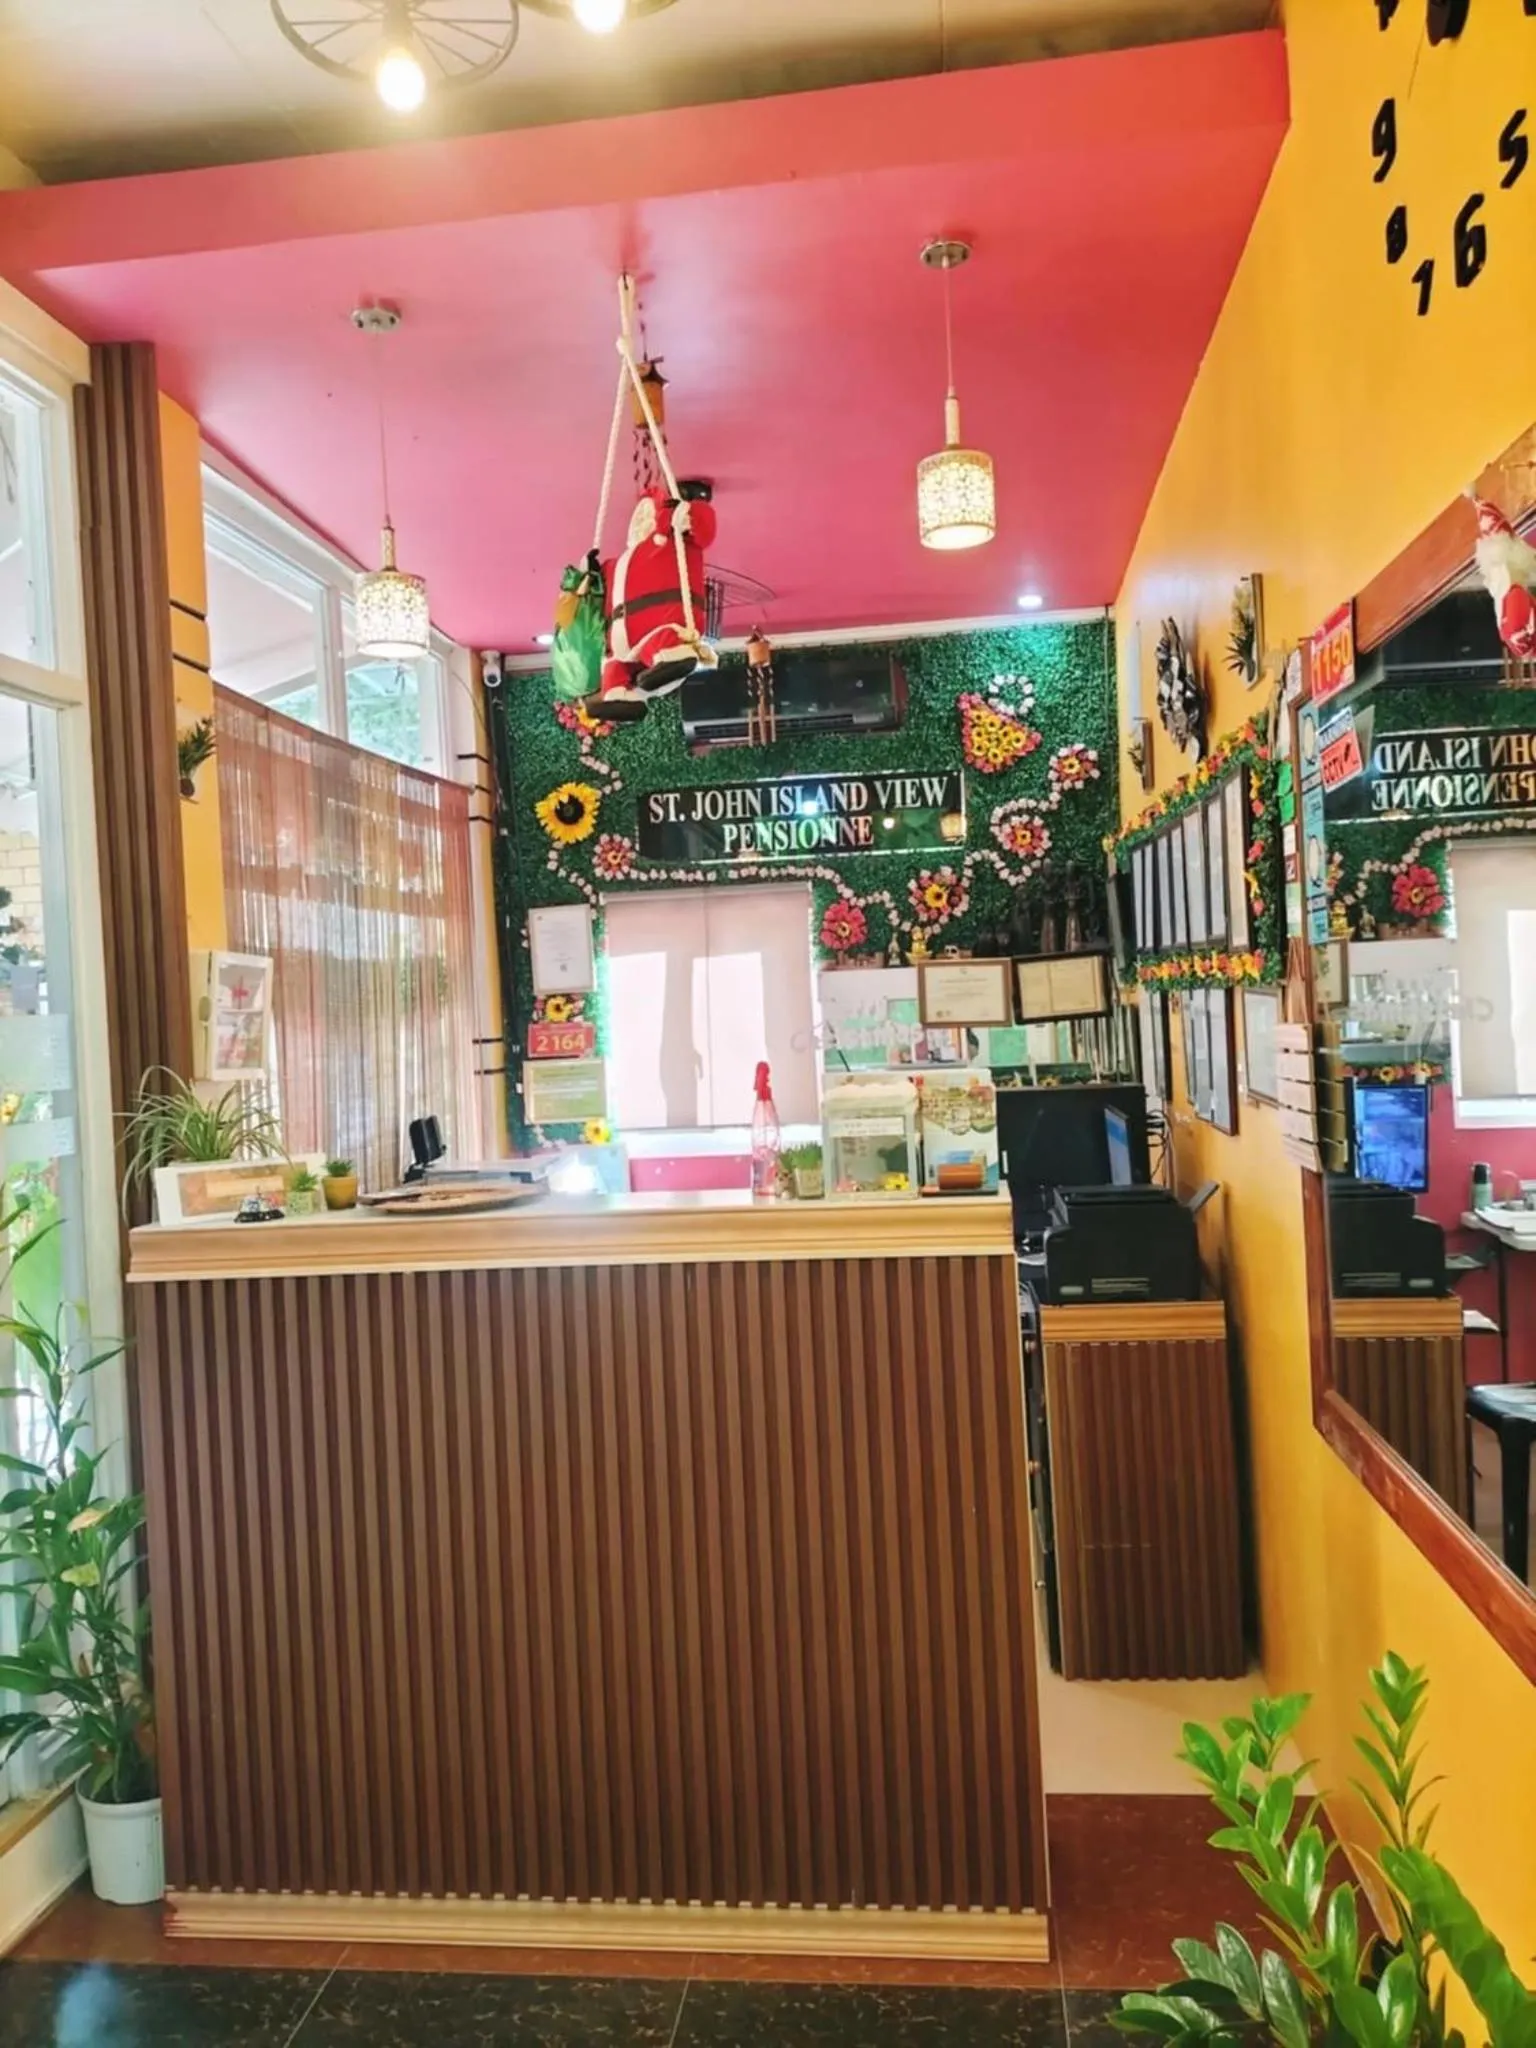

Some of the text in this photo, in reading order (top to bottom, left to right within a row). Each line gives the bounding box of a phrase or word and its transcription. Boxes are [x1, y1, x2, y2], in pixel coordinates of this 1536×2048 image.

[1372, 98, 1397, 183] 9
[1499, 109, 1528, 189] 5
[1454, 193, 1486, 288] 6
[648, 776, 948, 824] ST. JOHN ISLAND VIEW
[722, 815, 875, 854] PENSIONNE
